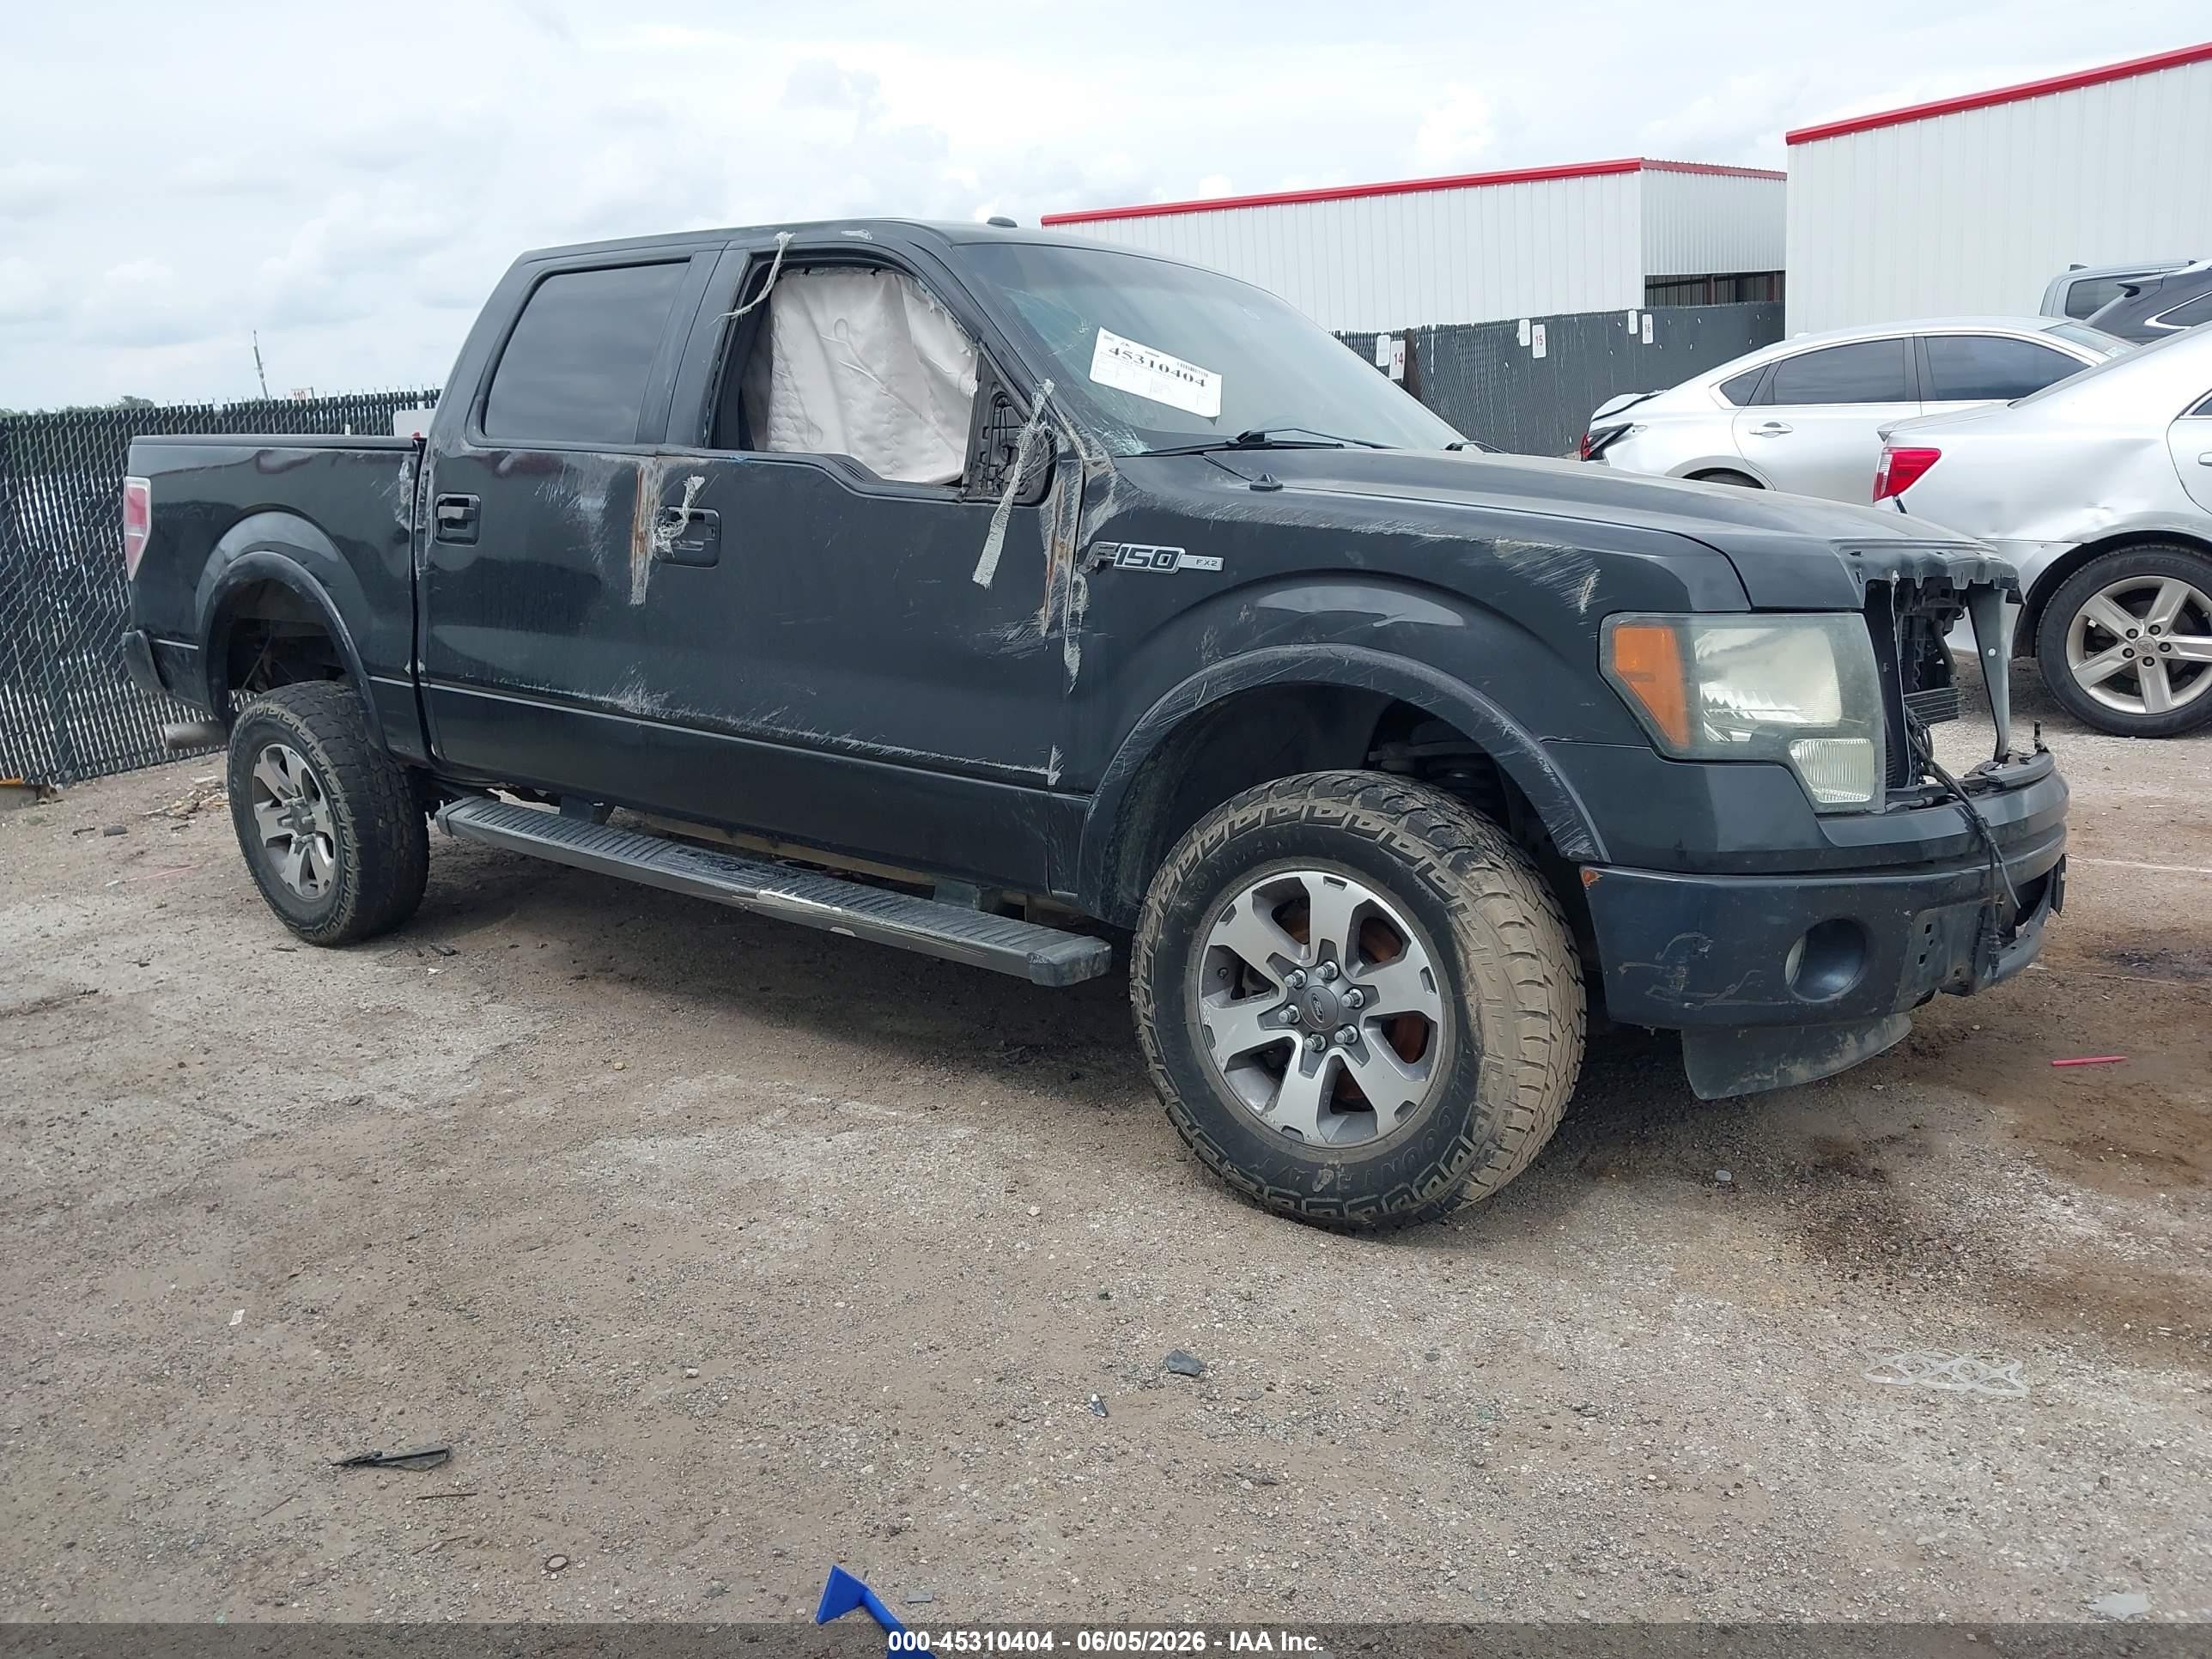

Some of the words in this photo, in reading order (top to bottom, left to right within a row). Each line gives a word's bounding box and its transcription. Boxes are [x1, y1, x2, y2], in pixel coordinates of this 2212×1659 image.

[1644, 323, 1651, 334] 16
[1535, 335, 1543, 346] 15
[1394, 352, 1404, 366] 14
[1109, 347, 1205, 388] 45310404
